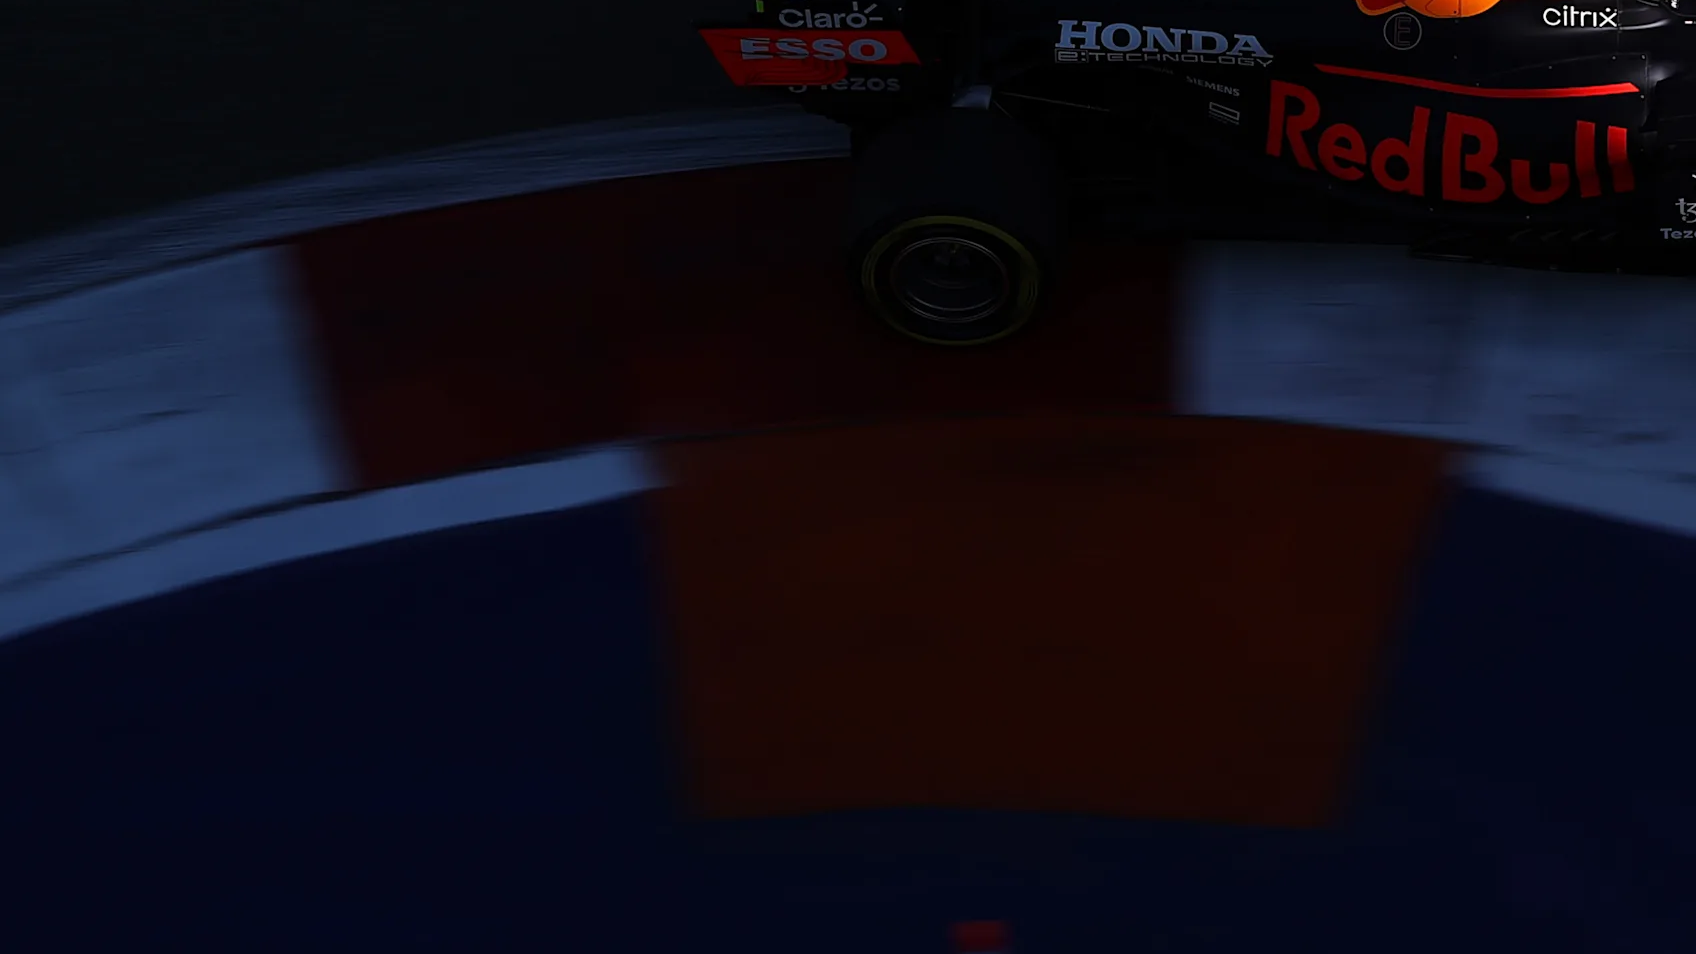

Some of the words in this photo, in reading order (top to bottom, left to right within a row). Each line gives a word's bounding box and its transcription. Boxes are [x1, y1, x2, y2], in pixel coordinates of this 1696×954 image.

[778, 8, 868, 29] Claro
[1542, 5, 1619, 29] citrix
[740, 37, 888, 62] ESSO
[1055, 19, 1275, 59] HONDA
[820, 77, 901, 92] ezos
[1185, 75, 1241, 97] SIEMENS
